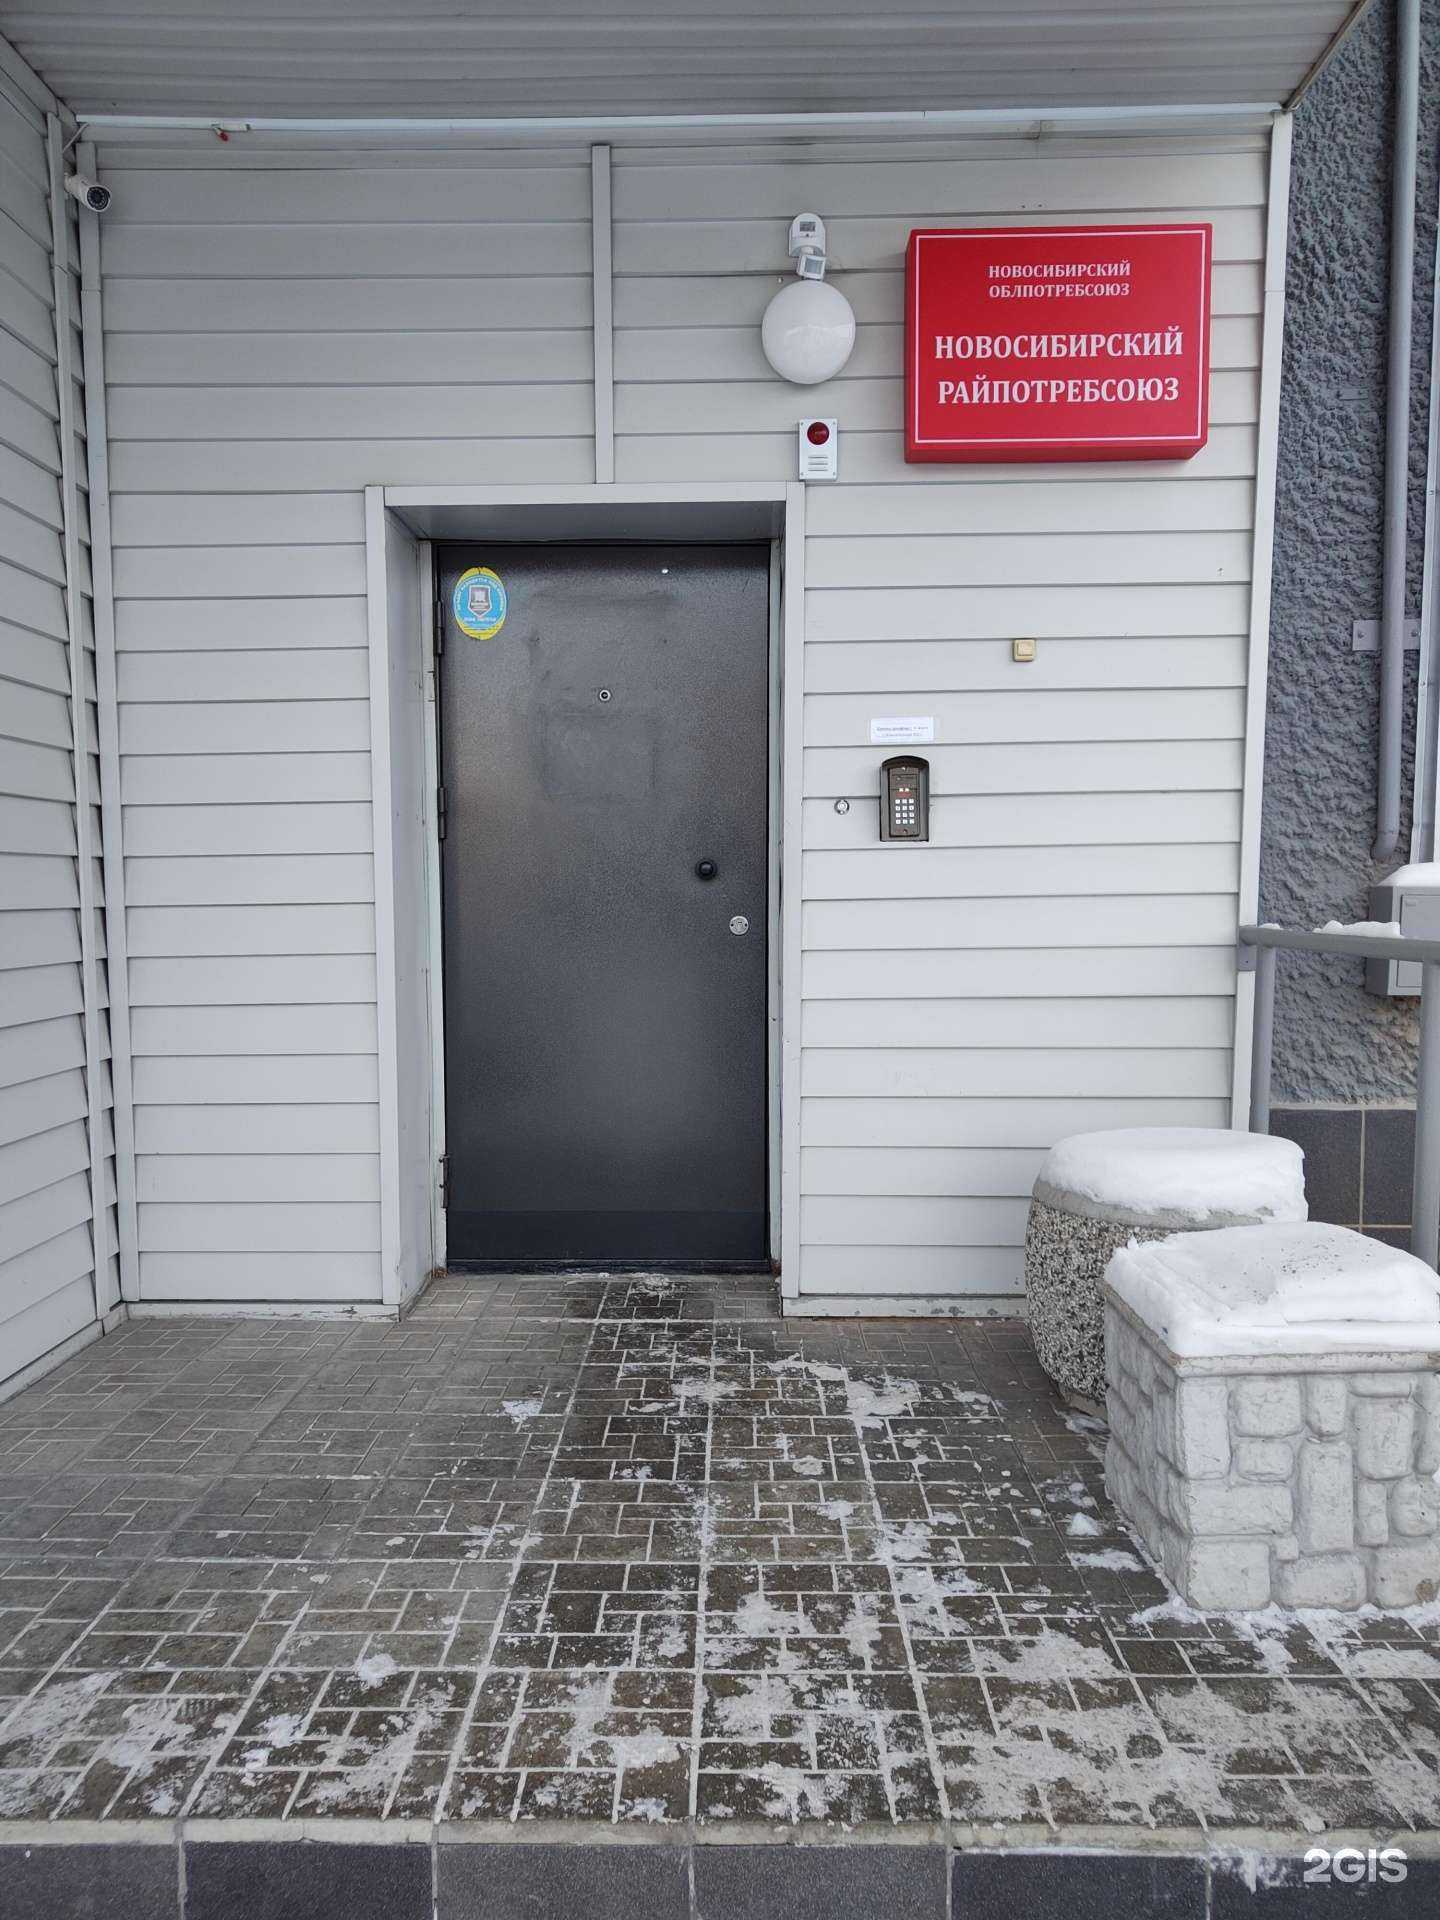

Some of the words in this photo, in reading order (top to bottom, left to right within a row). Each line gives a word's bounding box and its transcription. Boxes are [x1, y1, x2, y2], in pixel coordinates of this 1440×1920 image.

[989, 261, 1131, 278] НОВОСИБИРСКИЙ
[989, 282, 1130, 298] ОБЛПОТРЕБСОЮЗ
[935, 326, 1184, 359] НОВОСИБИРСКИЙ
[938, 375, 1179, 404] РАЙПОТРЕБСОЮЗ
